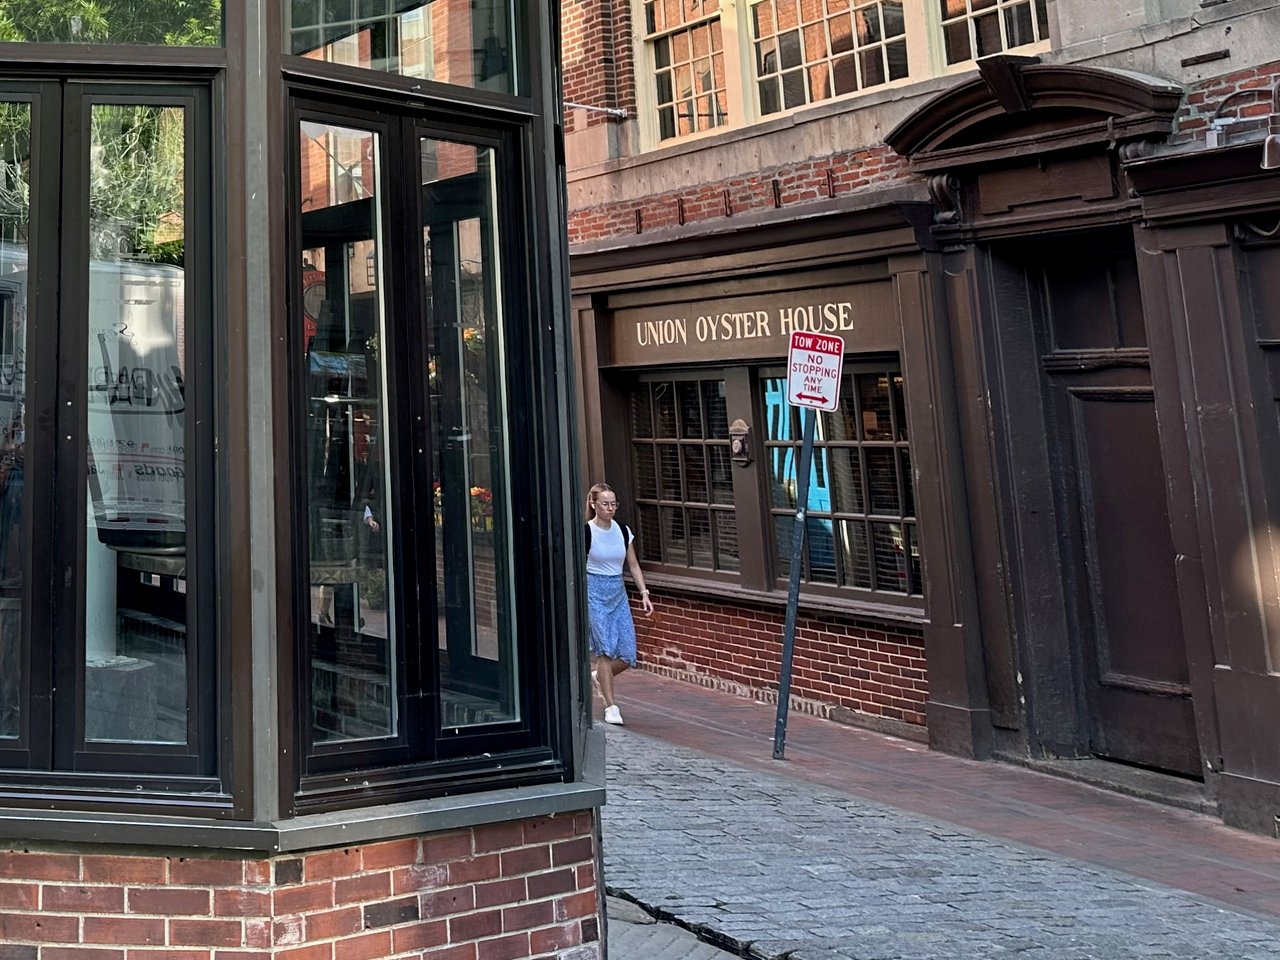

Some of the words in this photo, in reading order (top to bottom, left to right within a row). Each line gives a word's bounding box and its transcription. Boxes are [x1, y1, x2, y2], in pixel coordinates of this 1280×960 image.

[636, 318, 688, 348] UNION
[695, 310, 771, 342] OYSTER
[779, 302, 854, 336] HOUSE
[794, 335, 813, 349] TOW
[815, 337, 840, 353] ZONE
[807, 354, 823, 365] NO
[792, 362, 837, 379] STOPPING
[803, 375, 823, 385] ANY
[803, 383, 822, 394] TIME
